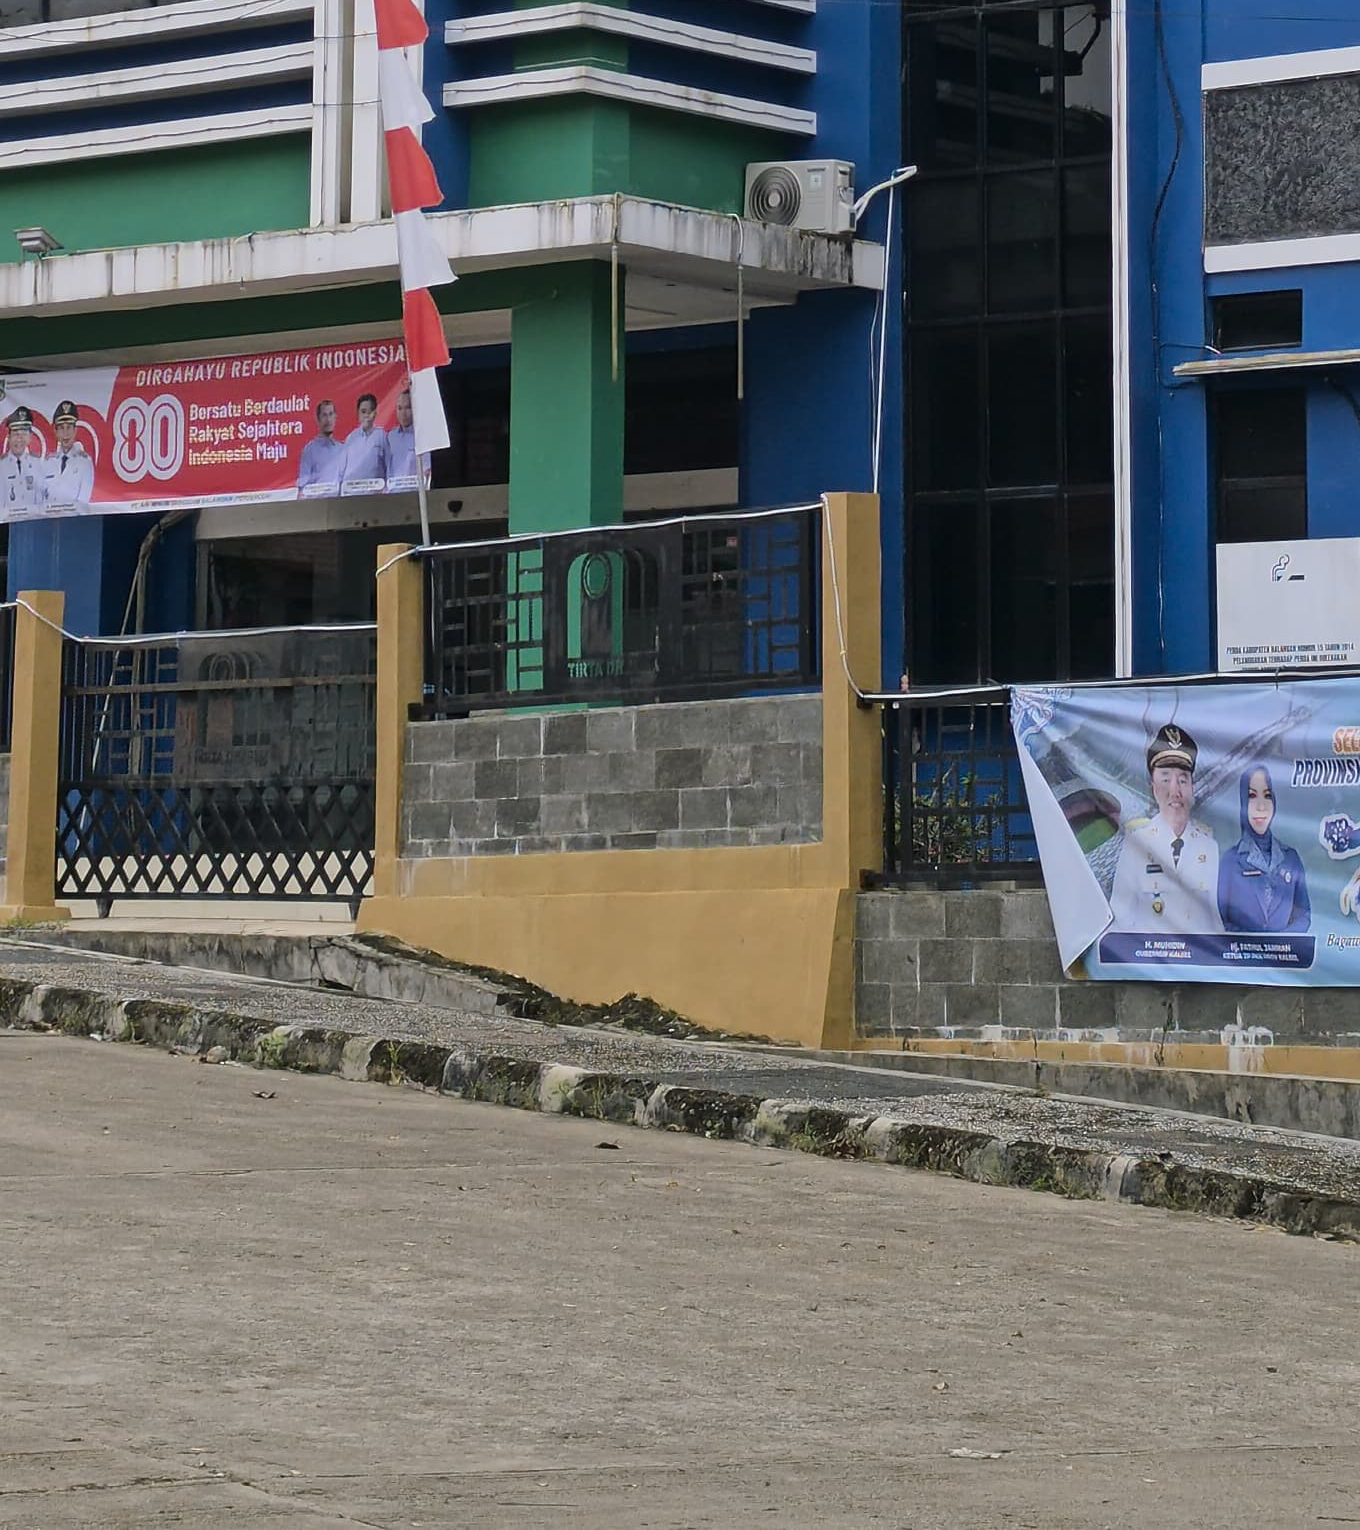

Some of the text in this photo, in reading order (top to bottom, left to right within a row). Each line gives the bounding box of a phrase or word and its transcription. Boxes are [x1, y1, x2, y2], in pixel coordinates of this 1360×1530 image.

[136, 344, 406, 387] DIRGAHAYU REPUBLIK INDONESIA
[189, 395, 310, 421] Bersatu Berdaulat
[112, 393, 185, 483] 80
[189, 420, 302, 445] Rakyat Sejahtera
[189, 442, 287, 466] Indonesia Maju
[1293, 757, 1360, 786] PROVINSI
